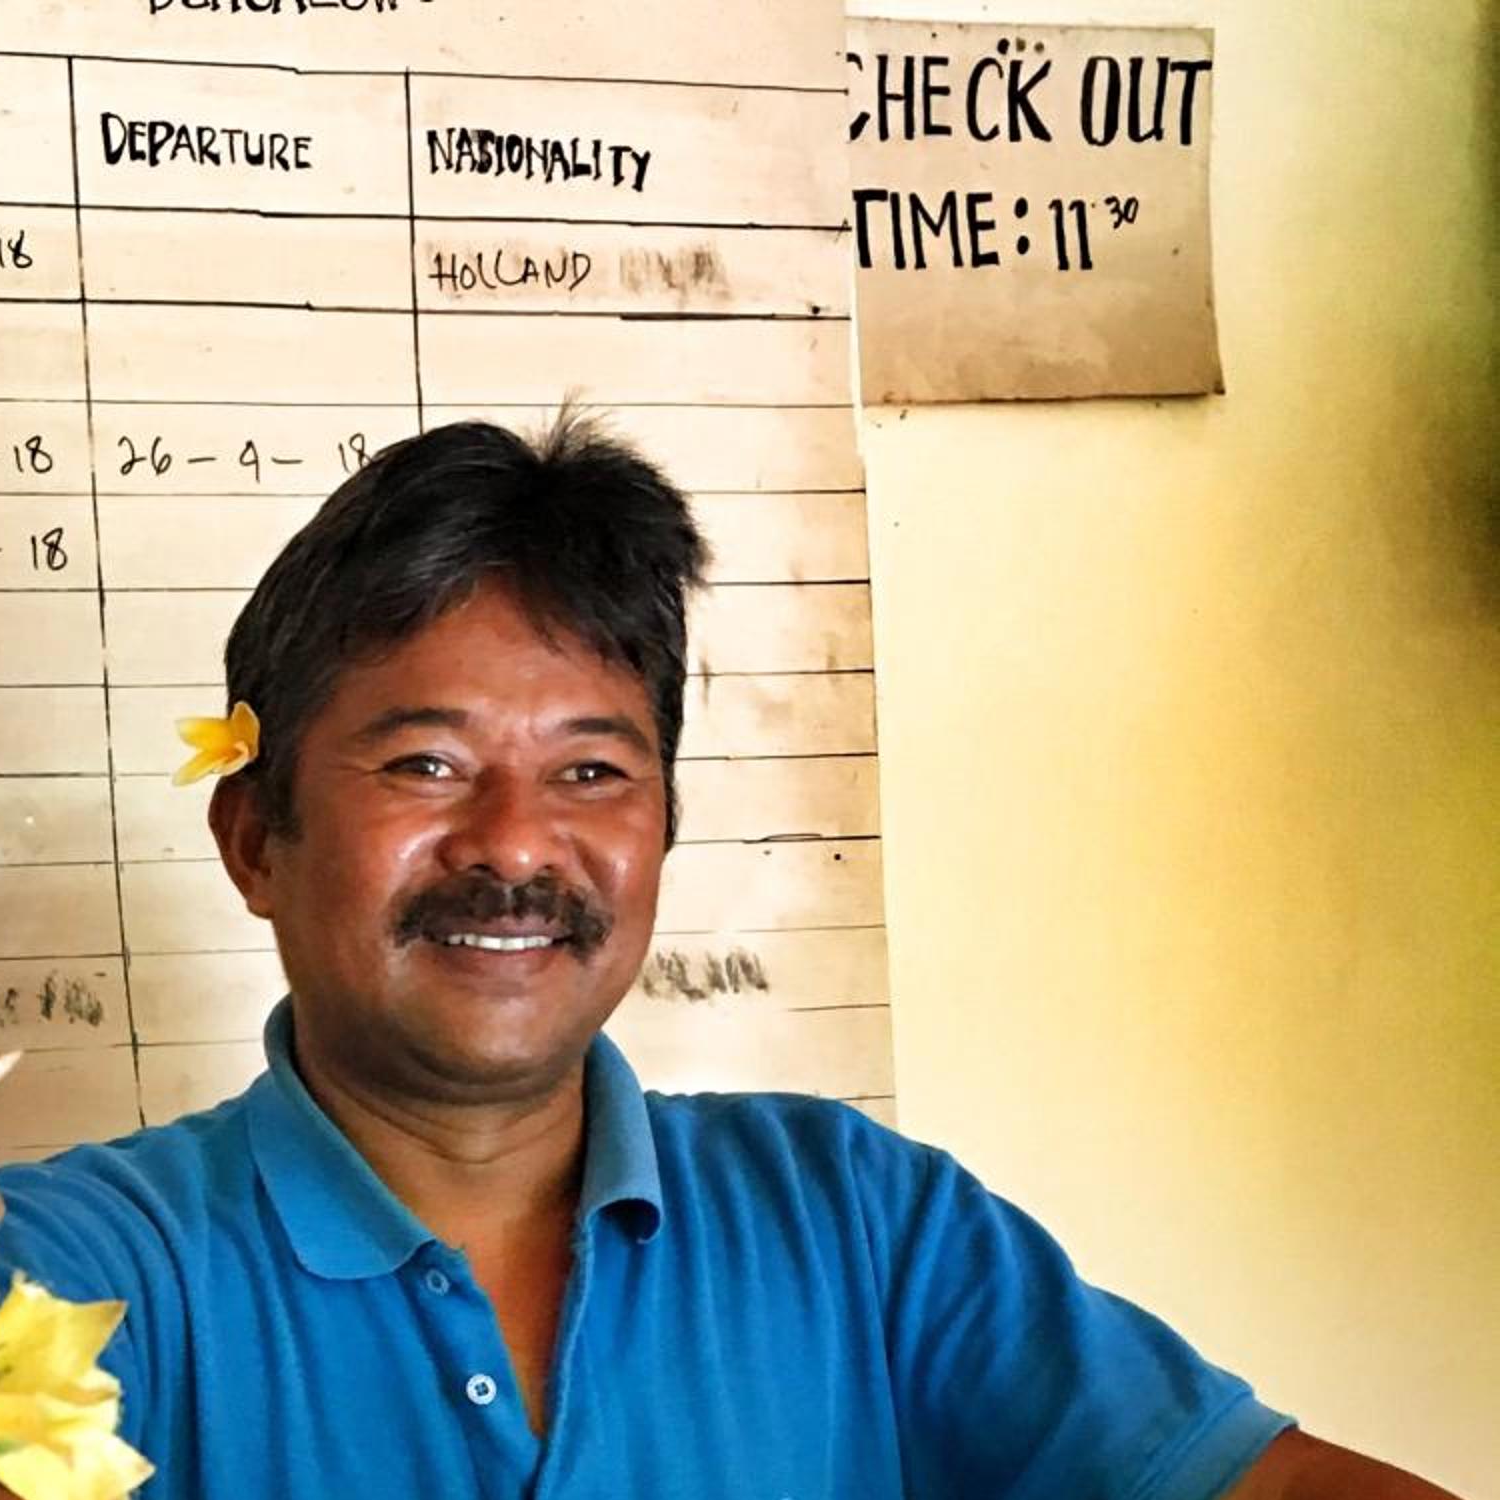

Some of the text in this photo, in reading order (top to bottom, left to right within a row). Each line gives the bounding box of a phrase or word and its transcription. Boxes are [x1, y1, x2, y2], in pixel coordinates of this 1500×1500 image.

[1080, 55, 1214, 148] OUT
[99, 111, 313, 173] DEPARTURE
[427, 248, 592, 292] HOLLAND
